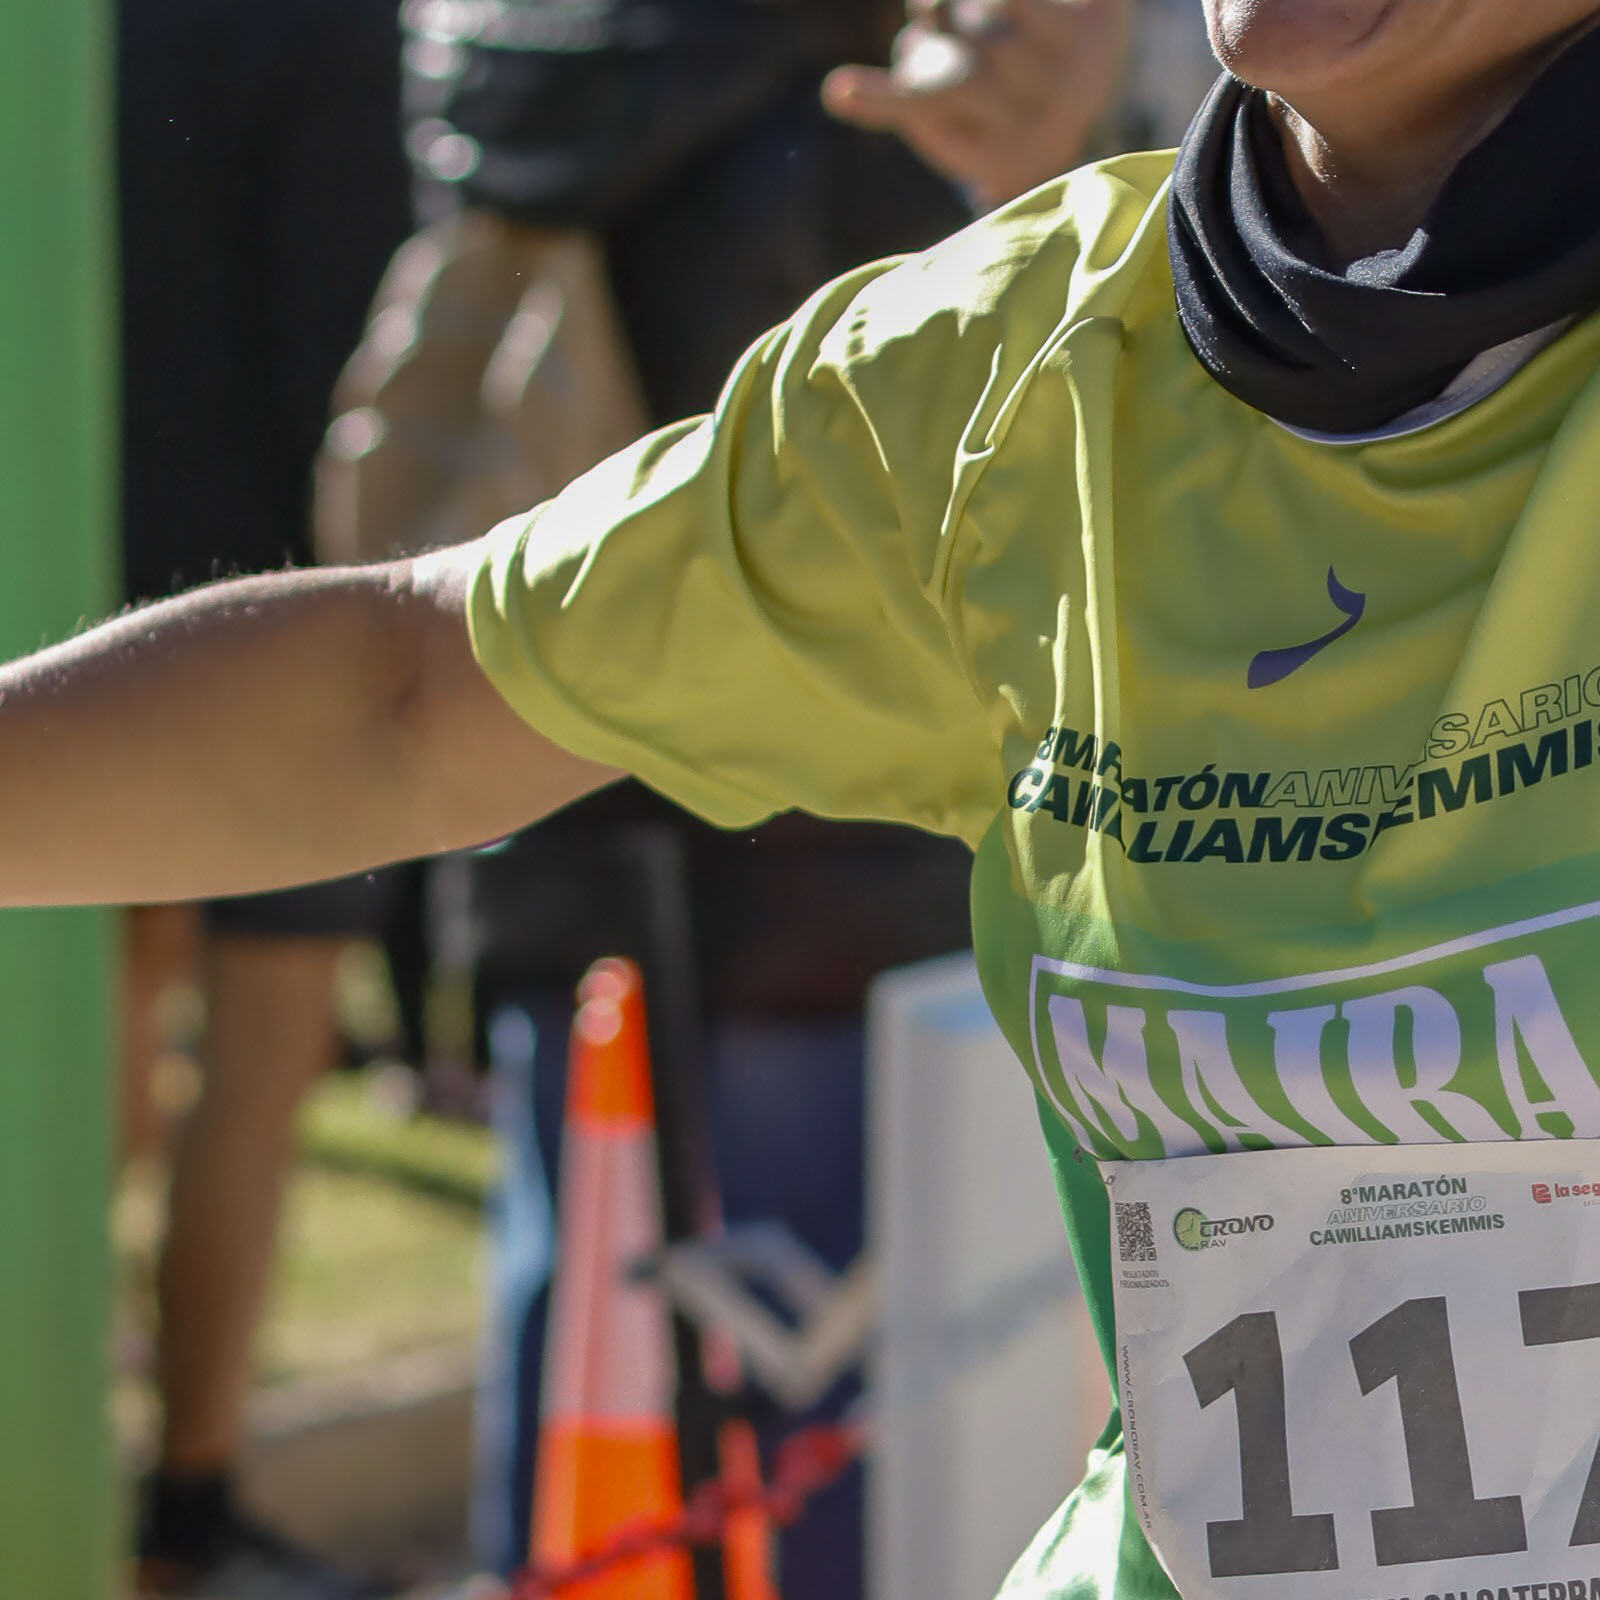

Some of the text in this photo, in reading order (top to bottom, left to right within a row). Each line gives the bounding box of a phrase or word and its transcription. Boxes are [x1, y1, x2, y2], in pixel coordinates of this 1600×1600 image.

[1555, 1184, 1569, 1198] la
[1326, 1196, 1488, 1225] ANIVERSARIO
[1309, 1214, 1506, 1246] CAWILLIAMSKEMMIS
[1201, 1239, 1227, 1249] RAV
